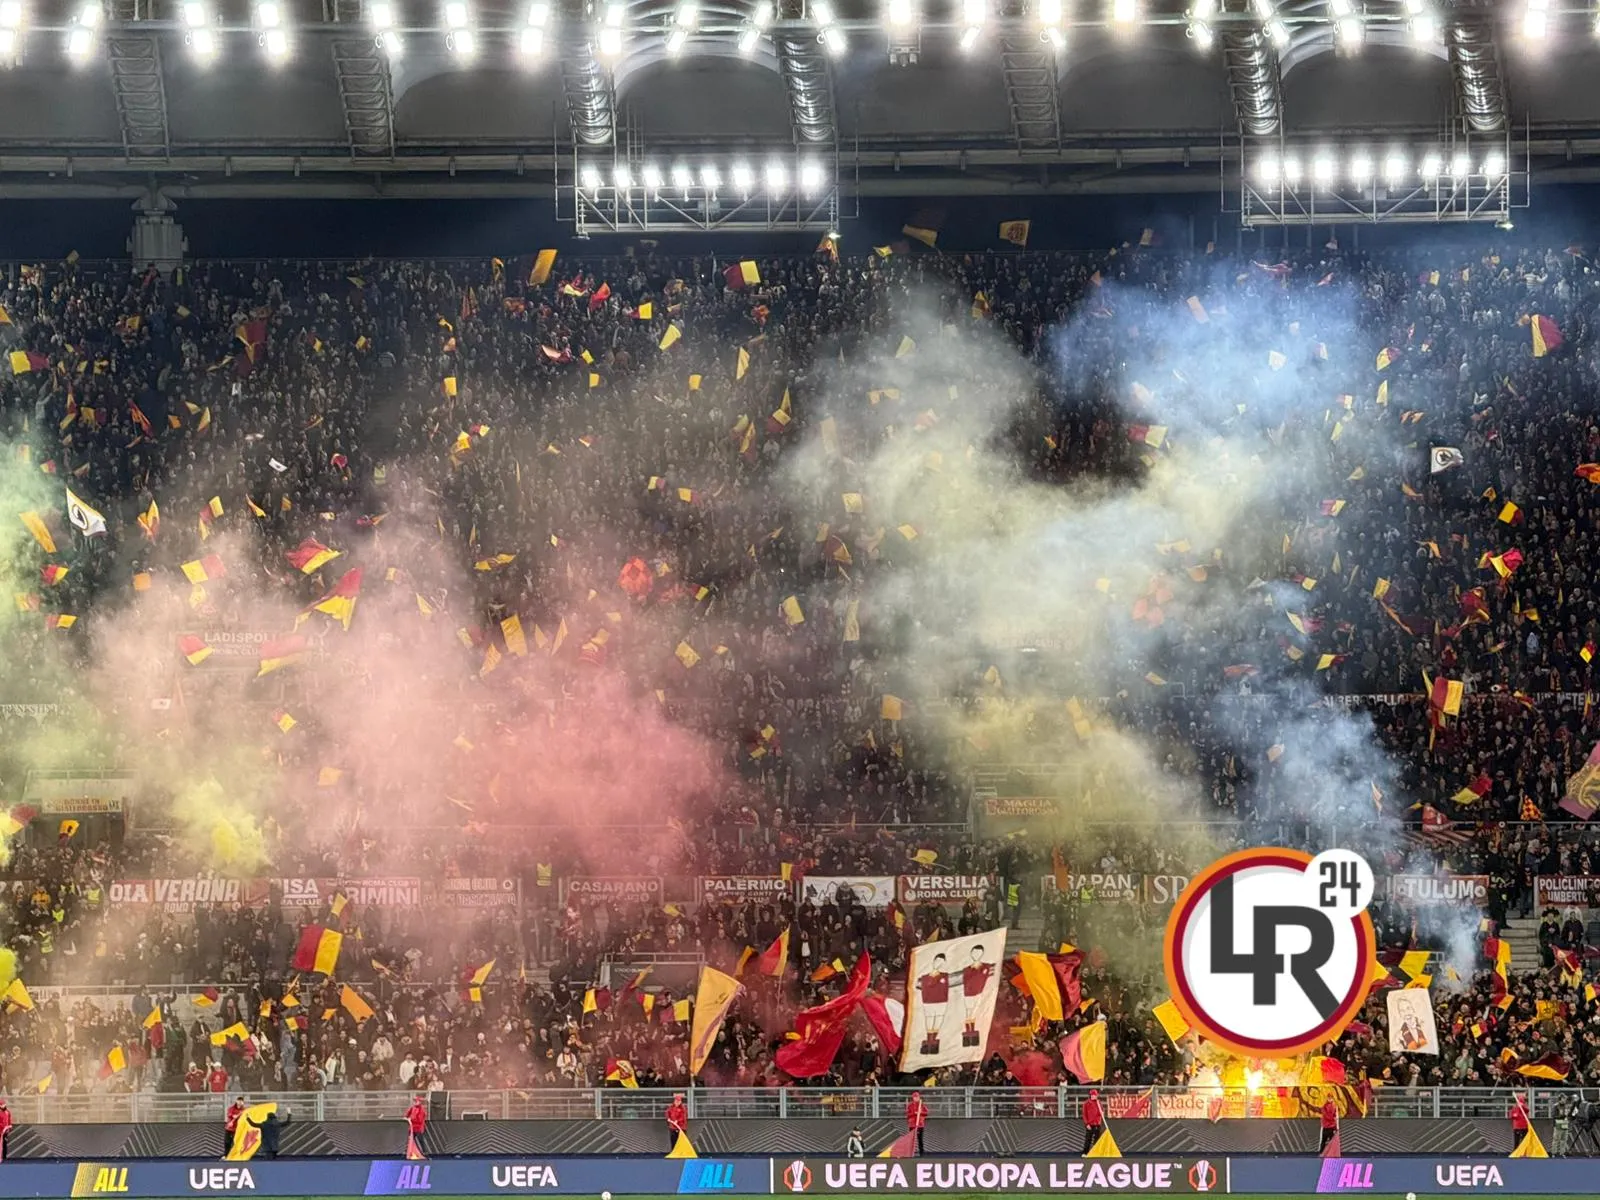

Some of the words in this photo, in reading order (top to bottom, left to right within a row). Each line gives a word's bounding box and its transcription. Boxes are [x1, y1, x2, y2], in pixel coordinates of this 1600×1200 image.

[271, 878, 319, 894] ISA
[570, 880, 658, 892] CASARANO
[704, 879, 786, 890] PALERMO
[907, 876, 990, 889] VERSILIA
[1404, 878, 1474, 899] TULUM
[344, 886, 418, 905] RIMINI
[917, 890, 947, 899] ROMA
[949, 890, 977, 899] CLUB
[1158, 1093, 1204, 1110] Made
[94, 1167, 128, 1192] ALL
[189, 1167, 255, 1190] UEFA
[396, 1165, 432, 1190] ALL
[492, 1165, 558, 1188] UEFA
[699, 1164, 735, 1188] ALL
[825, 1163, 908, 1188] UEFA
[917, 1163, 1042, 1188] EUROPA
[1048, 1163, 1172, 1188] LEAGUE
[1337, 1163, 1374, 1188] ALL
[1436, 1164, 1503, 1187] UEFA
